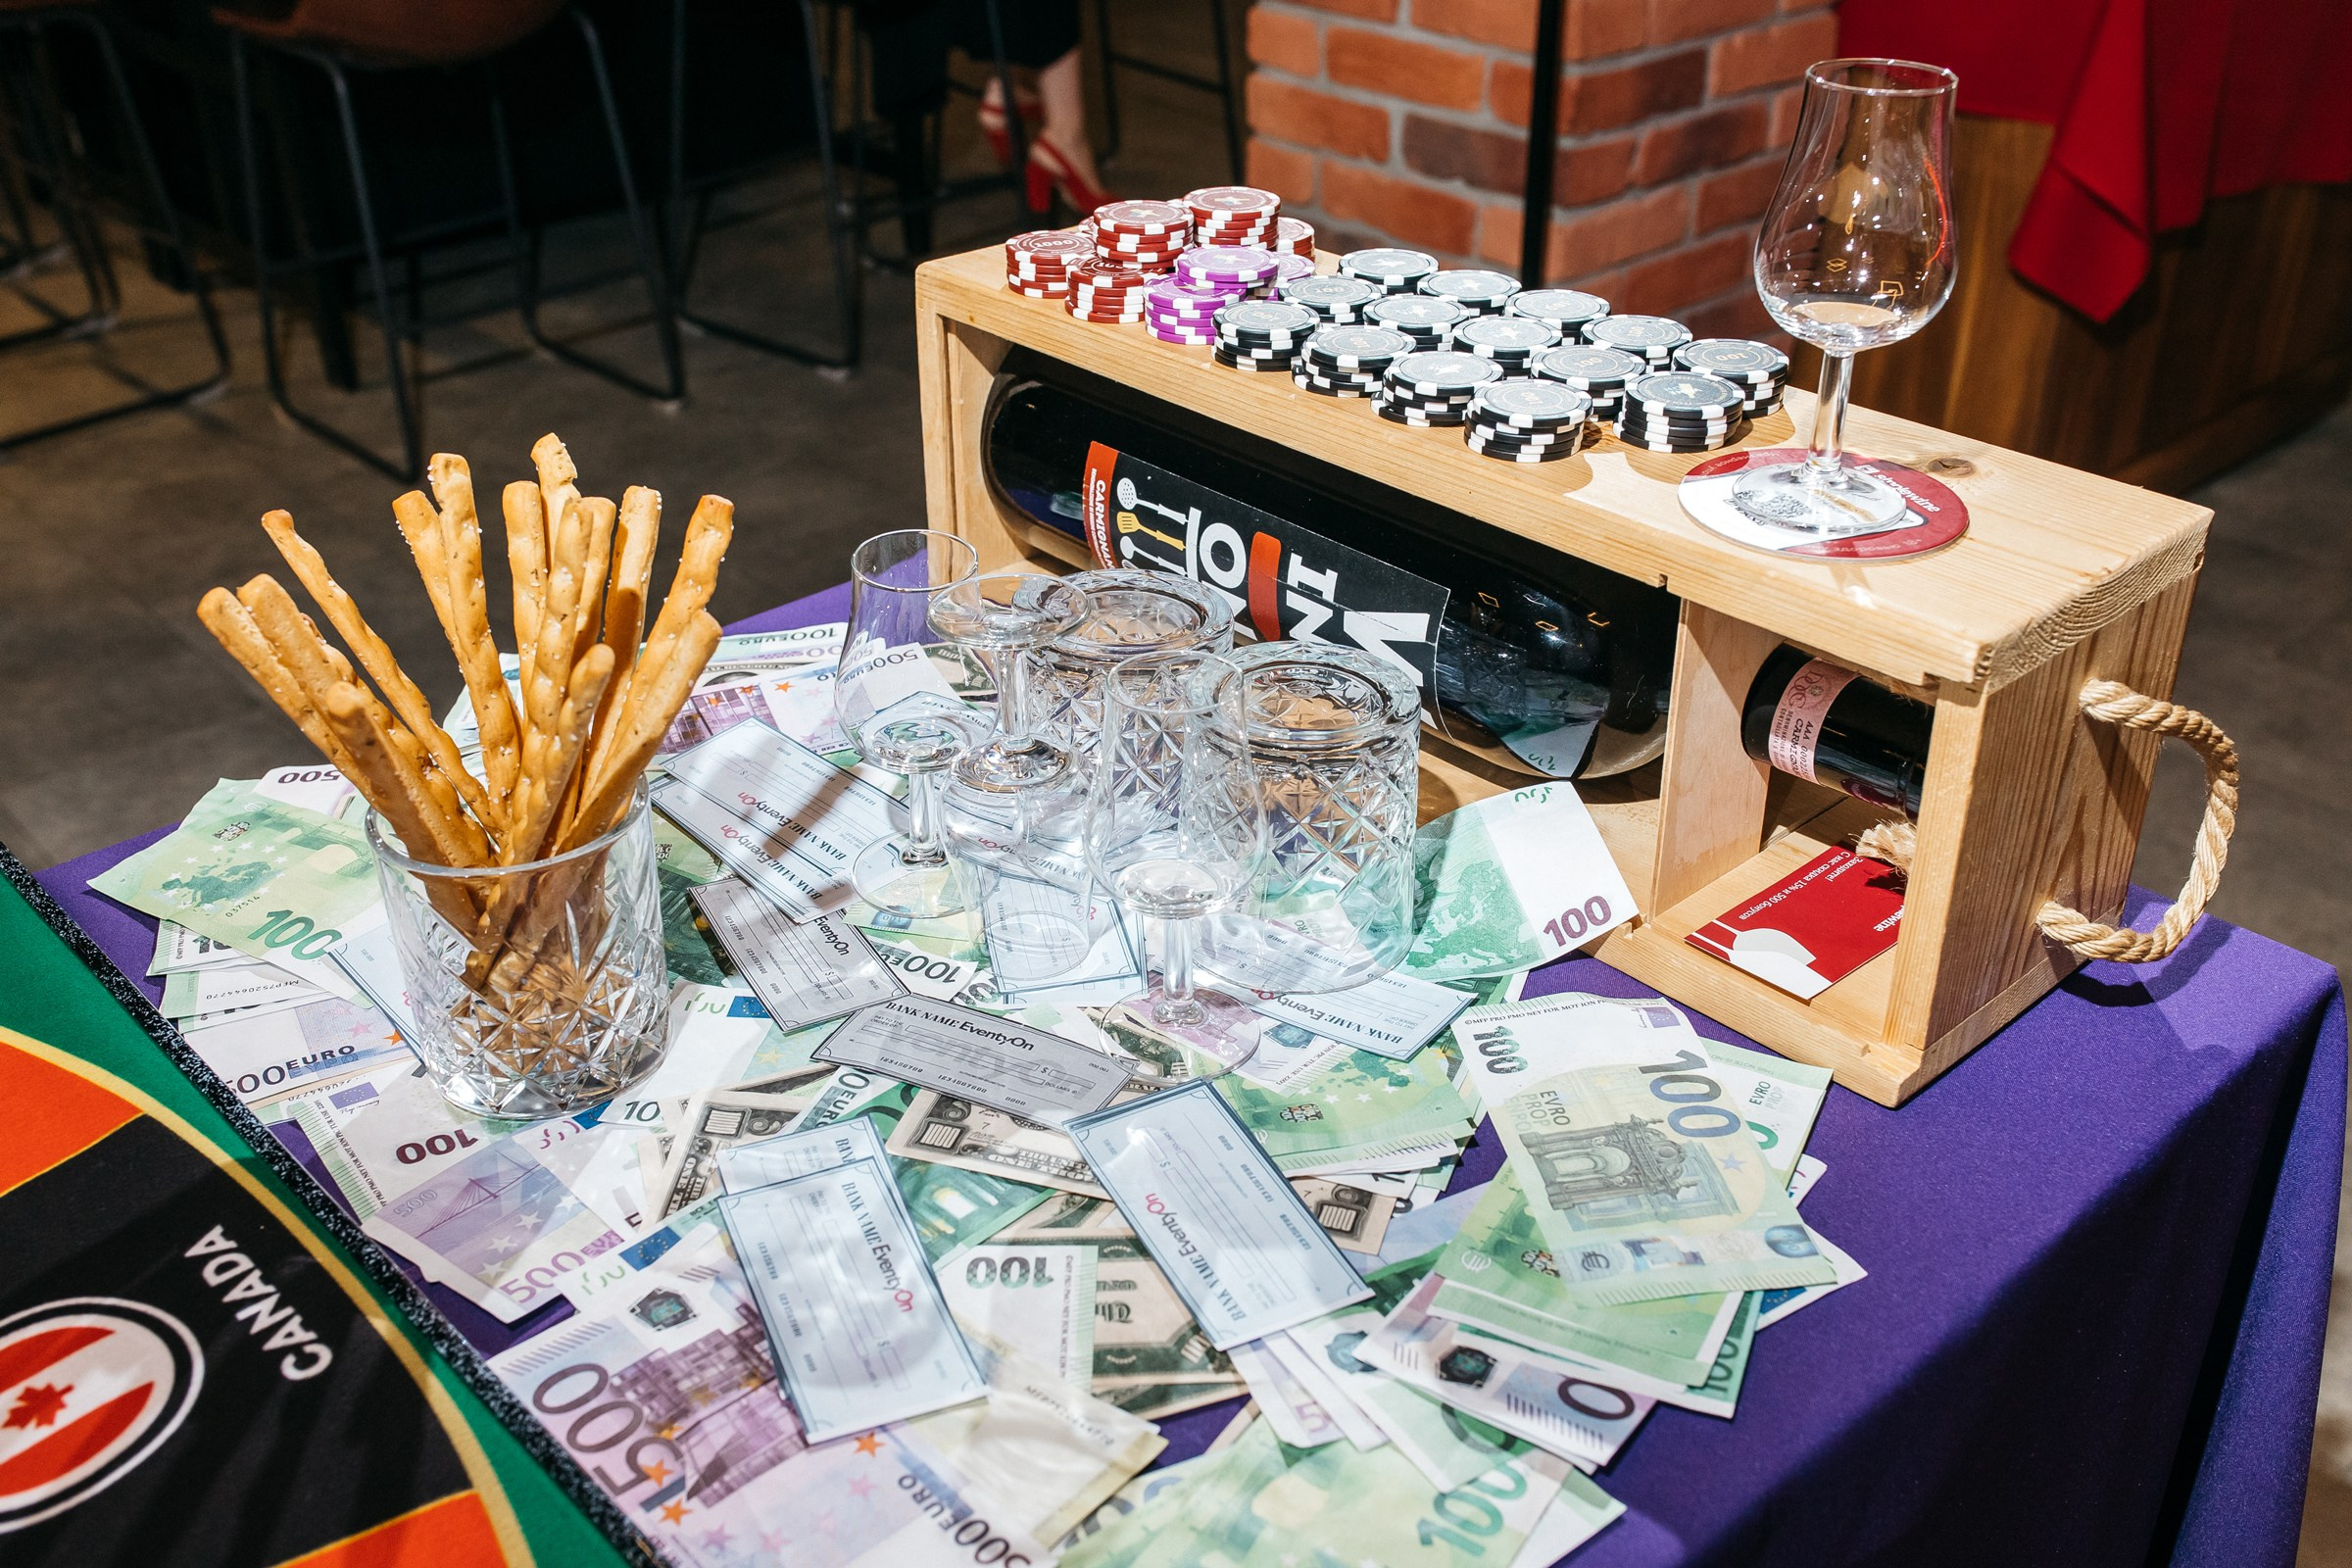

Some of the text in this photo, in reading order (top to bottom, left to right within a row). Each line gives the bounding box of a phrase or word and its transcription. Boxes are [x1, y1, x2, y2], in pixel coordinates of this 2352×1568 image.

[1034, 239, 1073, 248] 1000
[1096, 480, 1115, 568] CARMIGNAN
[791, 628, 837, 640] 100
[873, 648, 919, 668] 500
[737, 791, 848, 861] BANK NAME EventyOn
[720, 824, 774, 869] EventyOn
[798, 877, 824, 900] BANK
[1769, 893, 1787, 905] 500
[1788, 879, 1808, 891] 15%
[1543, 896, 1612, 948] 100
[1739, 901, 1772, 920] бонусов
[247, 909, 343, 960] 100
[813, 915, 851, 956] EventyOn
[902, 956, 961, 984] 100
[1324, 1014, 1367, 1037] NAME
[1527, 1008, 1542, 1017] NEY
[1543, 1005, 1560, 1015] FOR
[1561, 1003, 1579, 1011] MOT
[1581, 1000, 1596, 1008] ION
[885, 1002, 1034, 1051] BANK NAME EventyOn
[1368, 1027, 1403, 1045] BANK
[285, 1045, 355, 1069] EURO
[1473, 1025, 1528, 1074] 100
[1040, 1066, 1050, 1076] $
[1540, 1090, 1571, 1126] EVRO
[1638, 1050, 1740, 1137] 100
[1749, 1081, 1771, 1105] EVRO
[624, 1101, 662, 1122] 10
[396, 1129, 478, 1164] 100
[393, 1189, 438, 1217] 500
[1145, 1193, 1197, 1257] EventyOn
[500, 1250, 586, 1305] 500
[871, 1244, 913, 1313] EventyOn
[964, 1256, 1054, 1290] 100
[184, 1224, 333, 1381] CANADA
[533, 1363, 684, 1496] 500
[898, 1473, 959, 1533] EURO
[1418, 1459, 1528, 1557] 100
